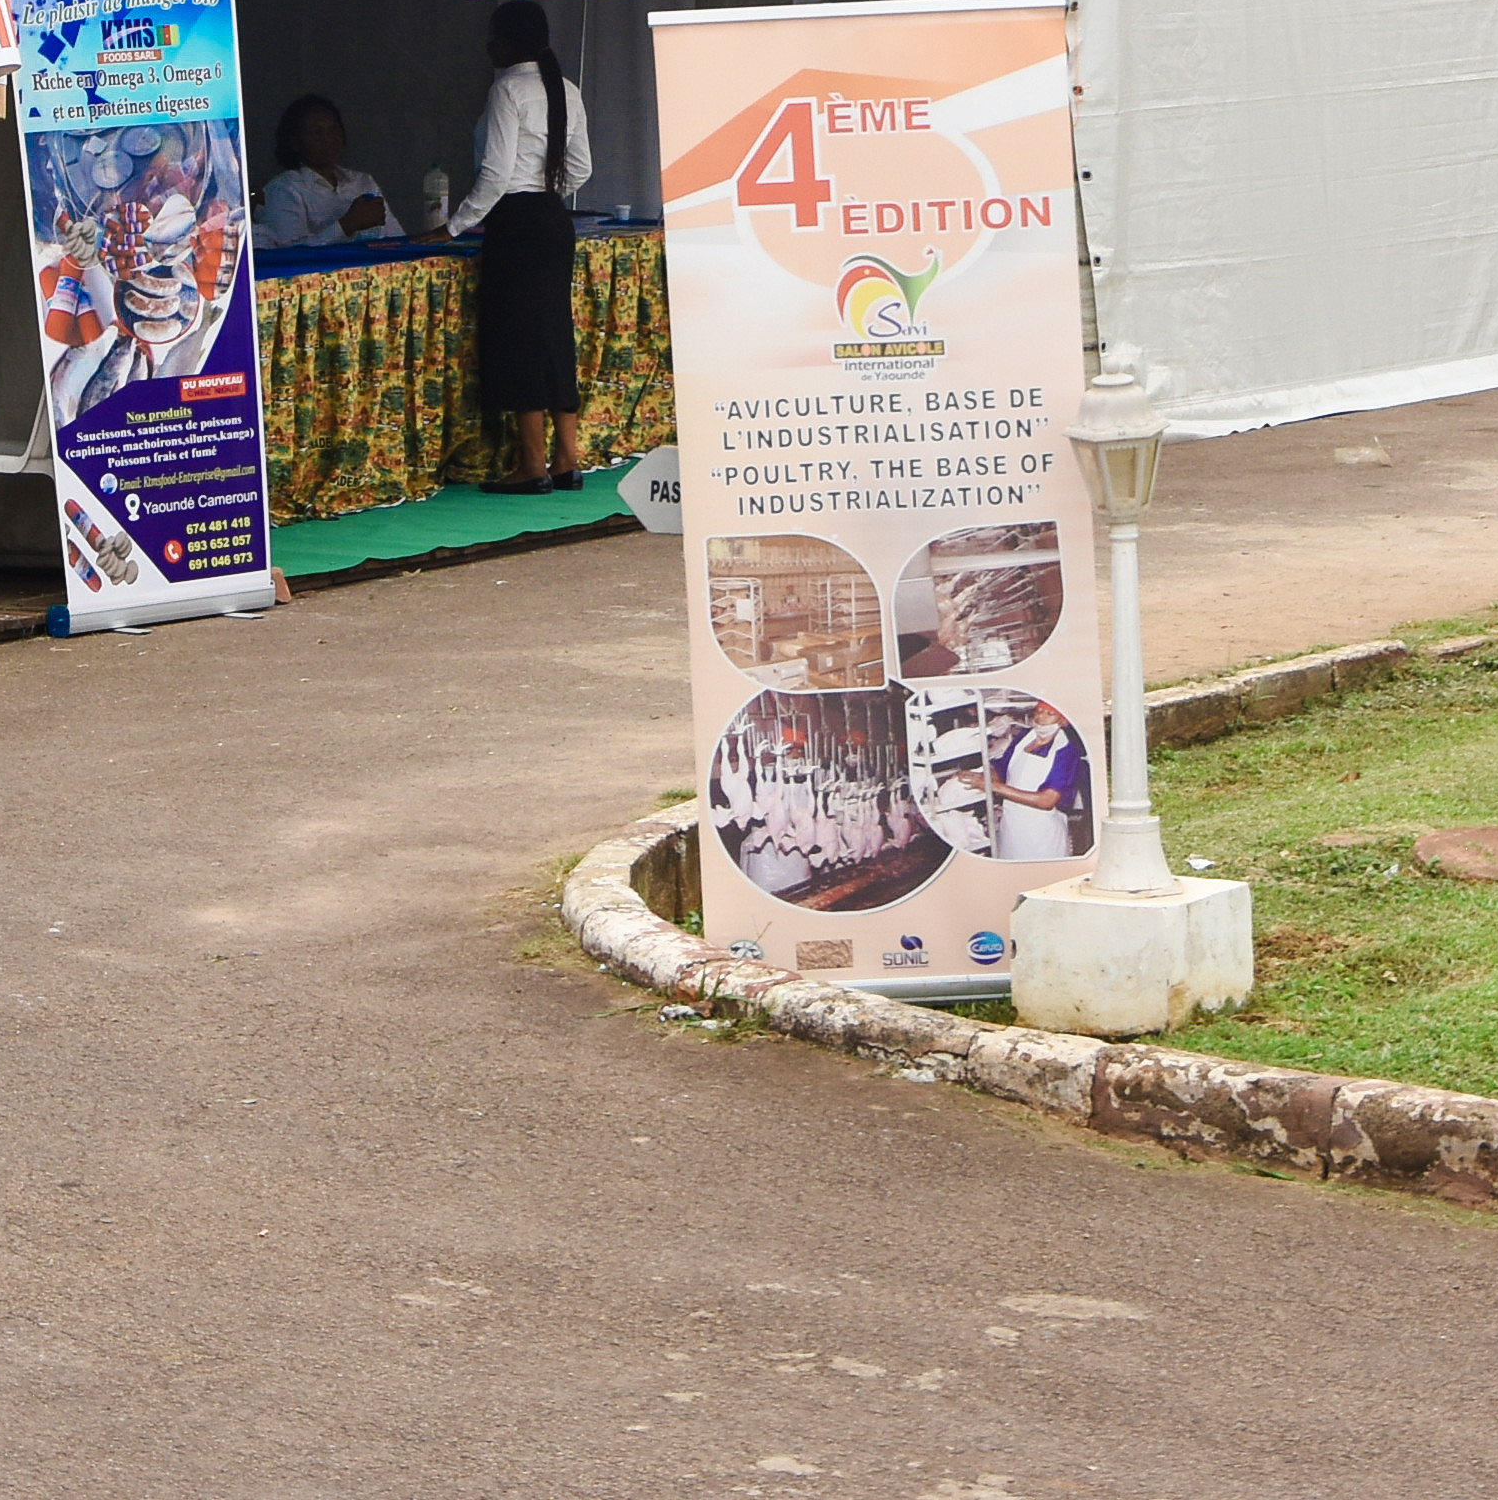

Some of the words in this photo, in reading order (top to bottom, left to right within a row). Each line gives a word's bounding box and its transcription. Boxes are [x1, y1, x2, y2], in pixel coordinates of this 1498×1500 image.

[22, 5, 46, 26] Le
[49, 1, 98, 30] plaisir
[101, 17, 155, 49] KTMS
[103, 52, 132, 63] FOODS
[135, 50, 157, 61] SARL
[32, 69, 73, 92] Riche
[76, 72, 93, 88] en
[95, 70, 145, 92] Omega
[163, 64, 213, 86] Omega
[215, 63, 222, 80] 6
[53, 106, 65, 120] et
[67, 106, 85, 119] en
[89, 99, 153, 123] protéines
[155, 96, 209, 117] digestes
[836, 344, 881, 358] SALON
[884, 341, 943, 356] AVICOLE
[845, 357, 935, 371] international
[182, 381, 197, 390] DU
[199, 376, 243, 388] NOUVEAU
[874, 370, 925, 381] Yaoundé
[187, 388, 211, 398] CHEZ
[925, 390, 996, 411] BASE
[1009, 387, 1043, 408] DE
[126, 412, 146, 422] Nos
[149, 406, 193, 422] produits
[77, 426, 135, 443] Saucissons,
[137, 422, 183, 436] saucisses
[185, 420, 198, 431] de
[201, 416, 242, 431] poissons
[65, 442, 121, 460] (capitaine,
[107, 455, 151, 468] Poissons
[153, 450, 177, 463] frais
[179, 450, 189, 460] et
[191, 446, 217, 459] fumé
[870, 457, 923, 480] THE
[935, 453, 1008, 478] BASE
[1019, 452, 1054, 474] OF
[119, 477, 142, 491] Email:
[143, 498, 195, 515] Yaoundé
[197, 491, 258, 509] Cameroun
[186, 522, 207, 535] 674
[209, 520, 229, 532] 481
[231, 516, 251, 530] 418
[187, 540, 208, 553] 693
[210, 538, 230, 550] 652
[232, 534, 252, 548] 057
[189, 558, 209, 570] 691
[211, 555, 231, 568] 046
[233, 552, 253, 565] 973
[883, 951, 929, 966] SONIC
